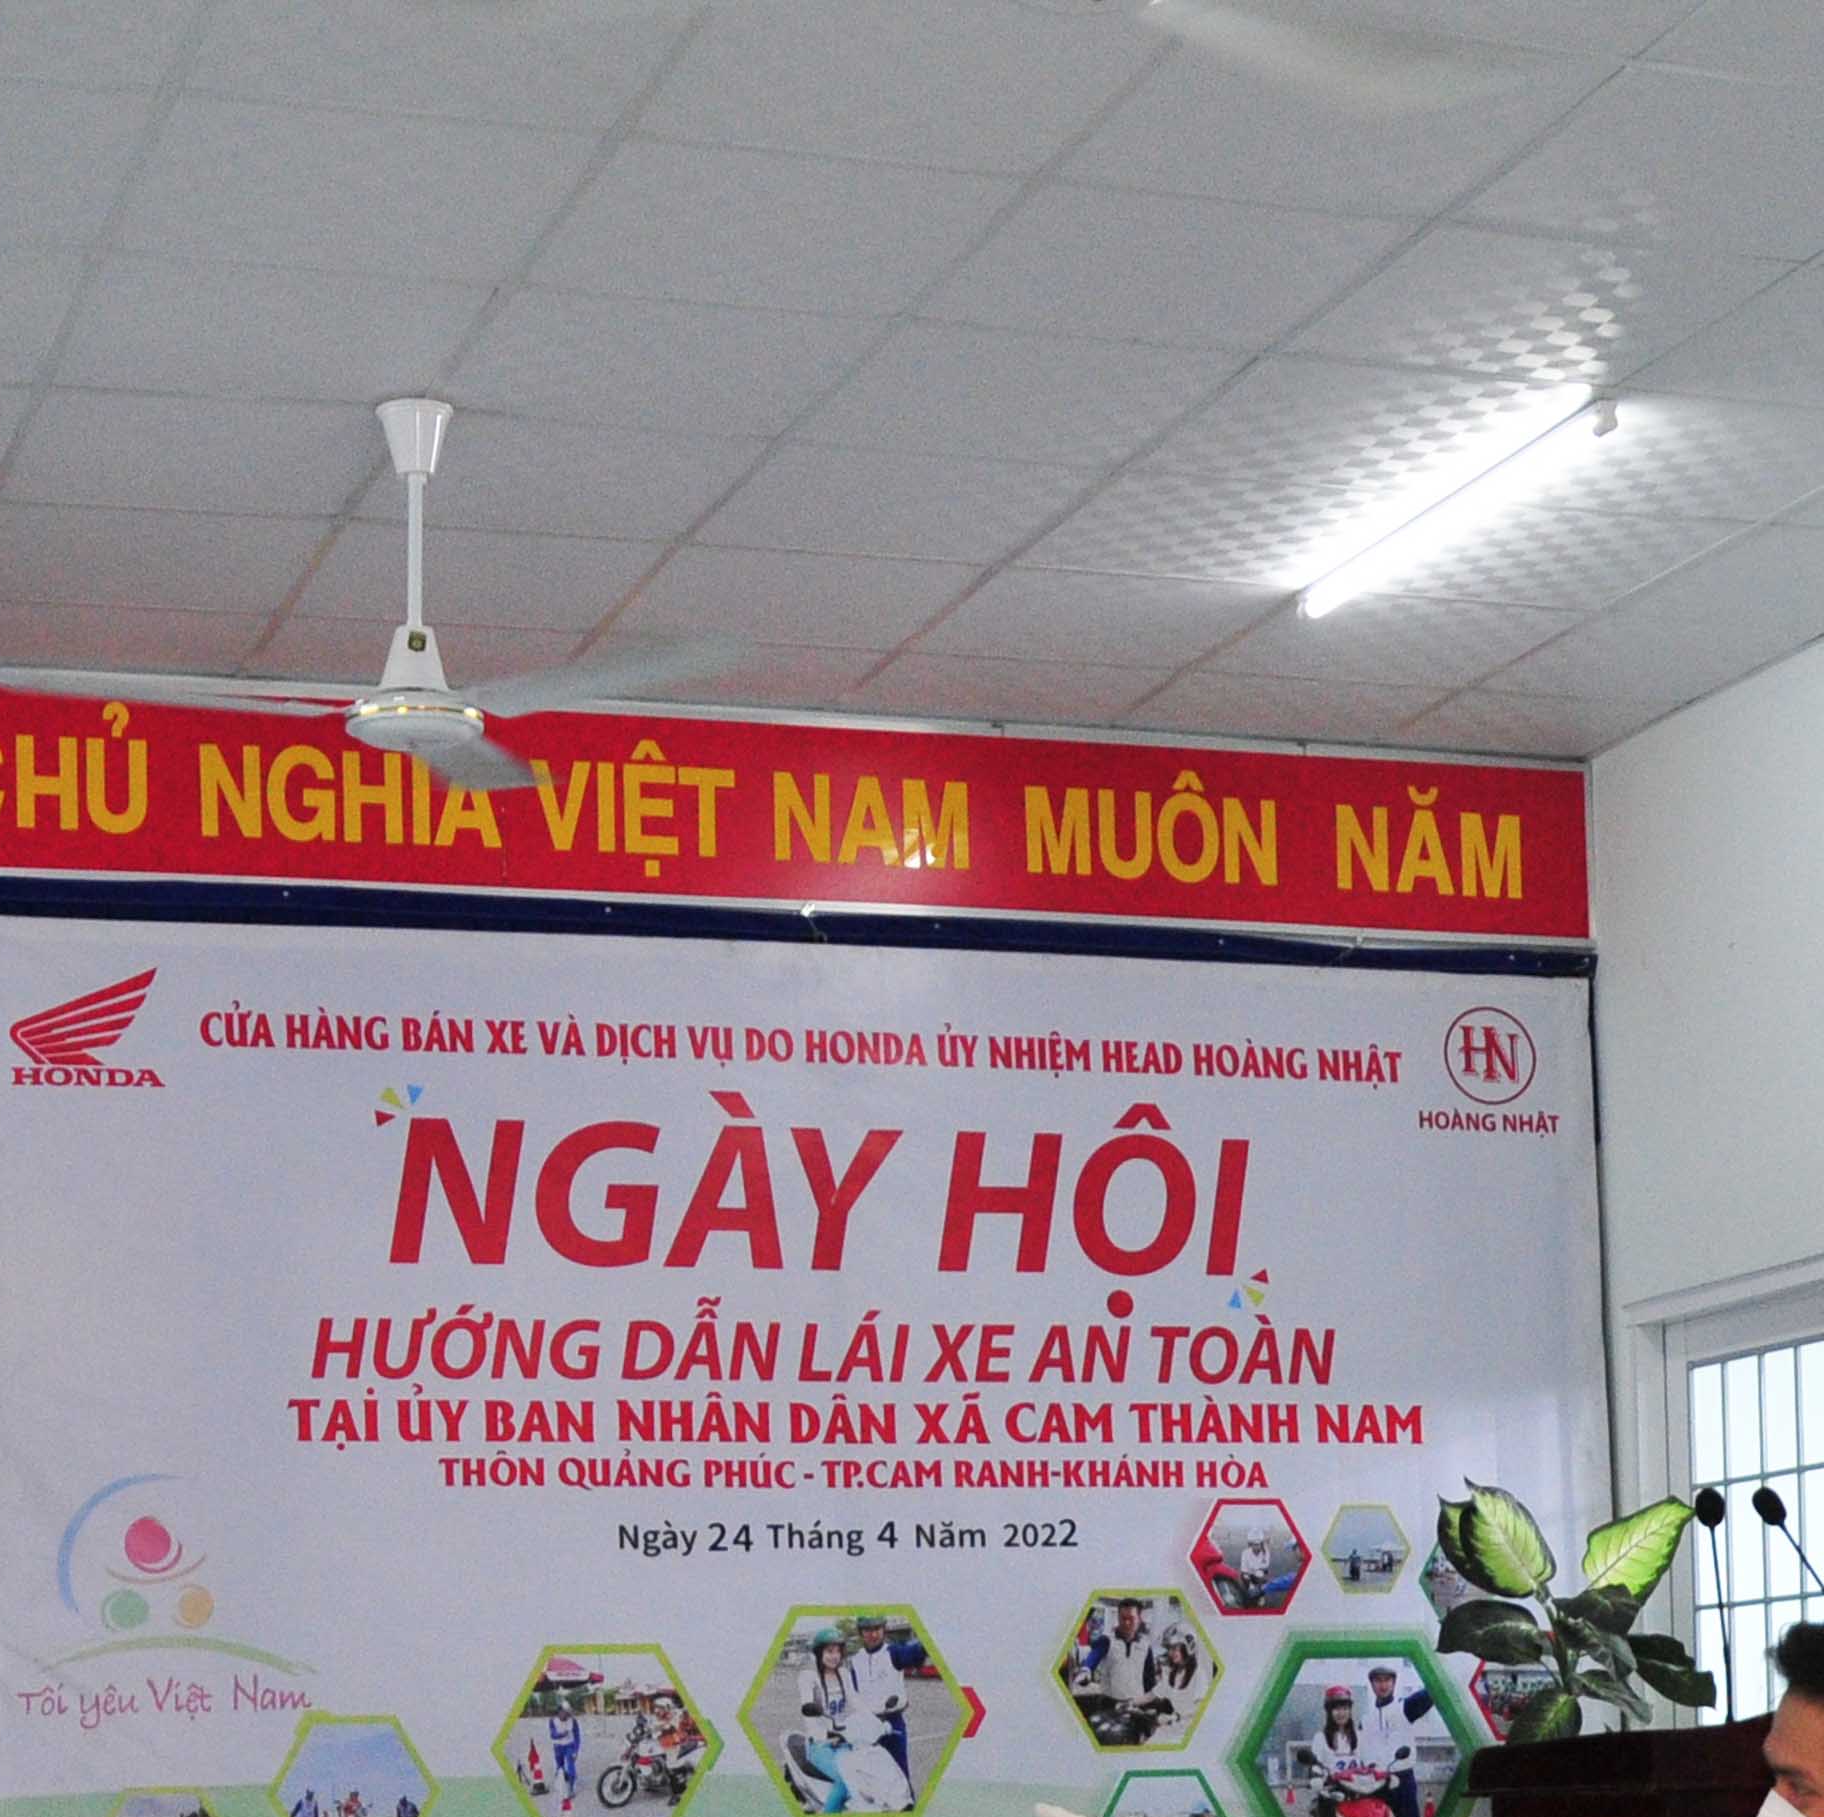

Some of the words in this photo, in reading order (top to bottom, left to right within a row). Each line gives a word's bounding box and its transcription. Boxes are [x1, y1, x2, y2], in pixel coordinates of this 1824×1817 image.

[529, 740, 734, 876] VIỆT
[774, 772, 970, 869] NAM
[1023, 771, 1278, 886] MUÔN
[1334, 784, 1523, 899] NĂM
[200, 1002, 273, 1049] CỬA
[286, 1010, 390, 1052] HÀNG
[401, 1010, 476, 1054] BÁN
[485, 1018, 527, 1056] XE
[538, 1011, 586, 1057] VÀ
[598, 1022, 678, 1067] DỊCH
[688, 1025, 735, 1067] VỤ
[745, 1028, 796, 1063] DO
[805, 1028, 928, 1067] HONDA
[937, 1022, 979, 1069] ỦY
[988, 1031, 1093, 1080] NHIỆM
[1102, 1039, 1184, 1076] HEAD
[1193, 1041, 1310, 1081] HOÀNG
[1317, 1041, 1403, 1088] NHẬT
[1460, 1025, 1519, 1083] HN
[11, 1066, 165, 1087] HONDA
[1419, 1107, 1496, 1132] HOÀNG
[1502, 1110, 1560, 1138] NHẬT
[389, 1090, 903, 1272] NGÀY
[936, 1103, 1250, 1318] HỘI
[311, 1303, 602, 1382] HƯỚNG
[621, 1295, 782, 1383] DẪN
[797, 1310, 910, 1384] LÁI
[924, 1324, 1030, 1385] XE
[1028, 1324, 1133, 1385] AN
[1150, 1314, 1337, 1387] TOÀN
[287, 1388, 380, 1451] TẠI
[397, 1383, 470, 1444] ỦY
[484, 1398, 596, 1445] BAN
[616, 1391, 772, 1445] NHÂN
[788, 1392, 898, 1446] DÂN
[914, 1391, 991, 1446] XÃ
[1004, 1401, 1115, 1445] CAM
[1129, 1396, 1300, 1445] THÀNH
[1315, 1403, 1424, 1446] NAM
[439, 1450, 547, 1488] THÔN
[558, 1448, 693, 1490] QUẢNG
[704, 1453, 794, 1490] PHÚC
[1195, 1454, 1269, 1490] HÒA
[618, 1520, 697, 1558] Ngày
[708, 1522, 754, 1553] 24
[766, 1520, 865, 1557] Tháng
[877, 1521, 898, 1549] 4
[915, 1521, 986, 1549] Năm
[1004, 1518, 1078, 1548] 2022
[18, 1683, 69, 1717] Tôi
[79, 1685, 139, 1729] yêu
[147, 1677, 213, 1721] Việt
[232, 1674, 314, 1711] Nam
